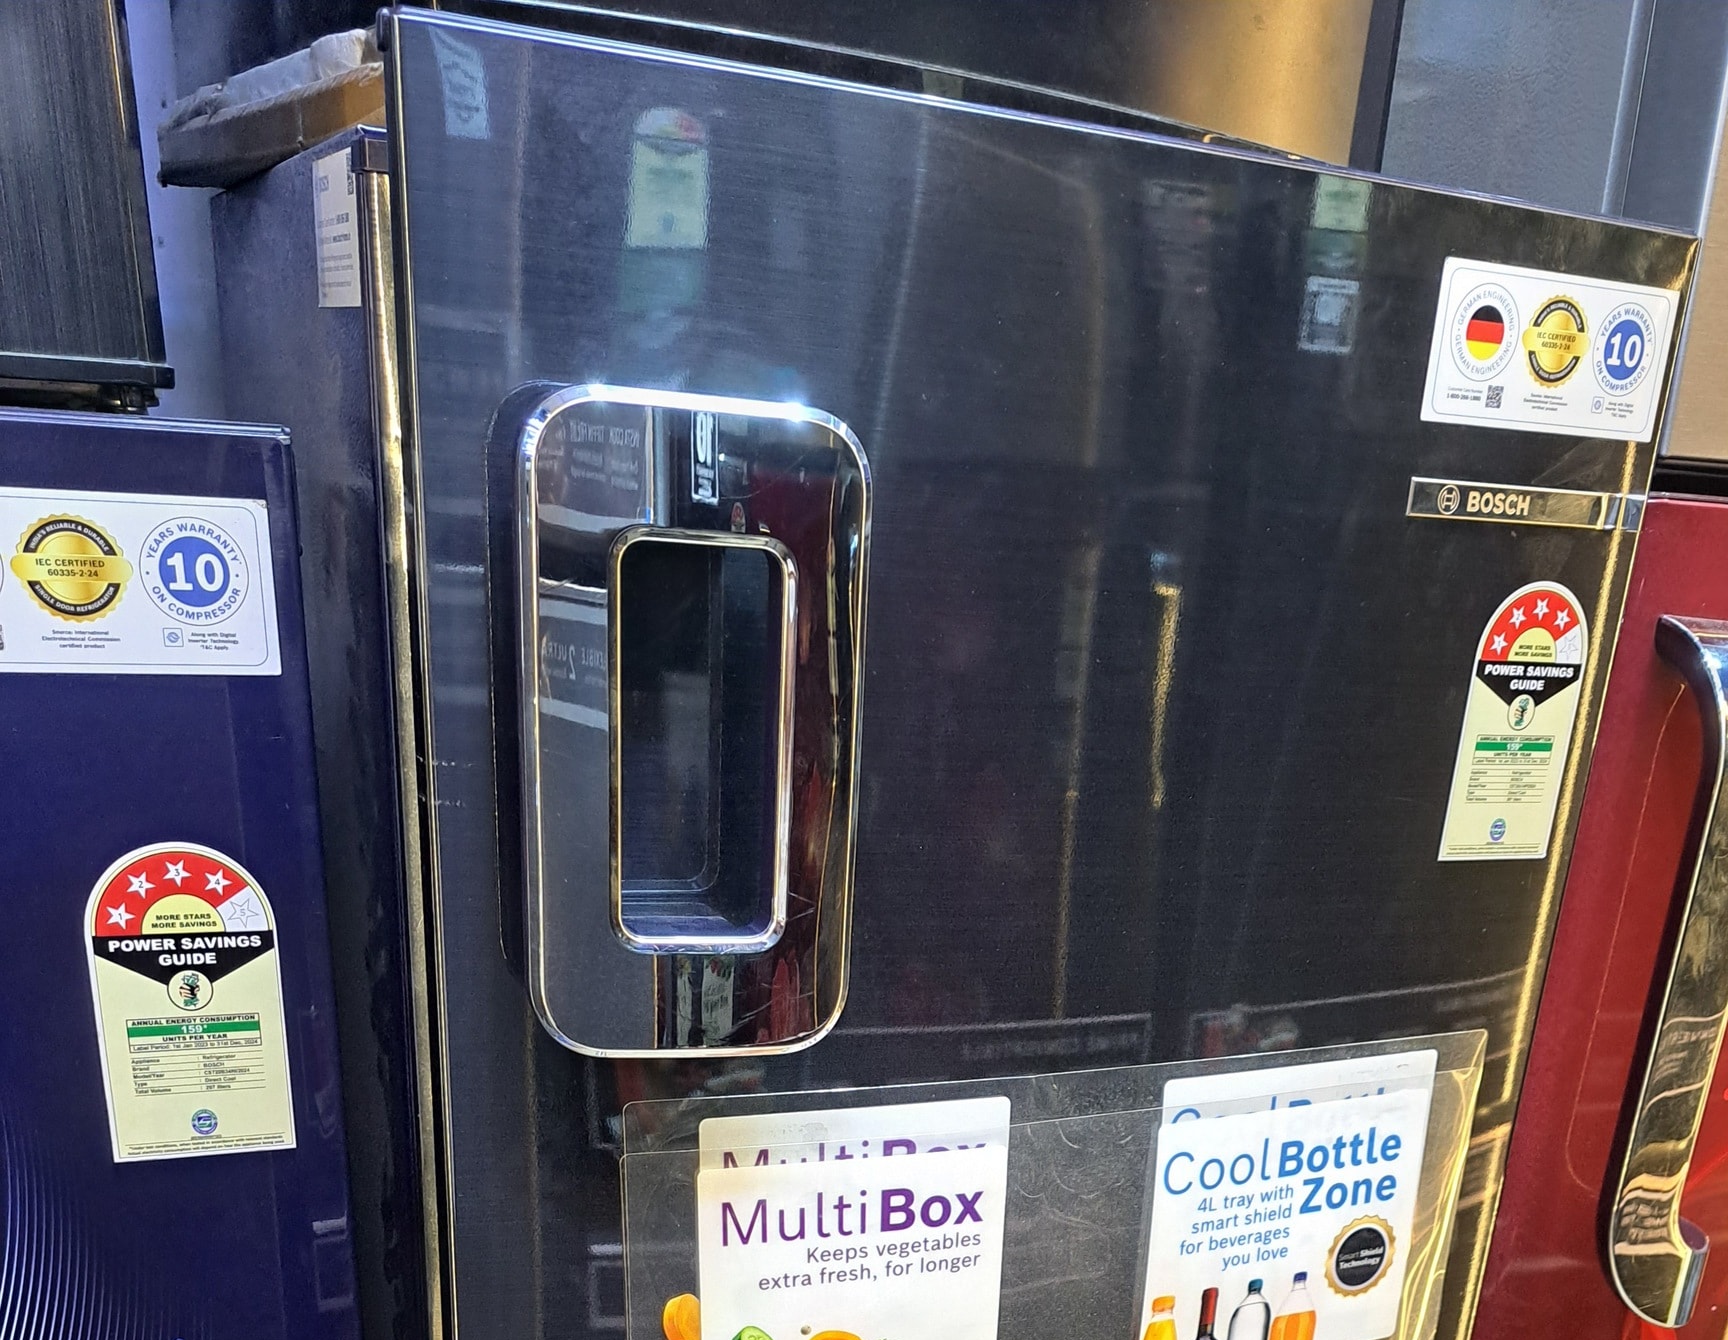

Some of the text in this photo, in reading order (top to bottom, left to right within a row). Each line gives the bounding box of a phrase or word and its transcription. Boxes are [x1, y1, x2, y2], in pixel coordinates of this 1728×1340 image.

[1458, 292, 1482, 325] GERMAN
[1483, 289, 1515, 331] ENGINEERING
[1600, 311, 1622, 337] YEARS
[1455, 334, 1471, 370] GERMAN
[1470, 341, 1513, 375] ENGINEERING
[1606, 332, 1644, 369] 10
[1595, 360, 1606, 382] ON
[1602, 366, 1646, 391] COMPRESSOR
[1466, 490, 1531, 516] BOSCH
[83, 527, 110, 552] DURABLE
[146, 527, 174, 560] YEARS
[35, 558, 105, 568] IEC CERTIFIED
[47, 568, 99, 578] 60335-2-24
[166, 552, 224, 593] 10
[34, 583, 55, 605] SINGLE
[56, 601, 75, 612] DOOR
[152, 585, 241, 621] ON COMPRESSOR
[1484, 664, 1574, 679] POWER SAVINGS
[1509, 679, 1545, 691] GUIDE
[138, 880, 144, 889] 2
[174, 868, 180, 877] 3
[214, 878, 221, 886] 4
[151, 920, 218, 929] MORE SAVINGS
[108, 935, 262, 953] POWER SAVINGS
[158, 952, 217, 967] GUIDE
[131, 1014, 256, 1027] ANNUAL ENERGY CONSUMPTION
[162, 1035, 187, 1043] UNITS
[206, 1033, 228, 1041] YEAR
[1197, 1184, 1294, 1213] 4L tray with
[1298, 1174, 1398, 1215] Zone
[1191, 1203, 1293, 1235] smart shield
[806, 1231, 982, 1266] Keeps vegetables
[1180, 1226, 1290, 1256] for beverages
[1339, 1246, 1384, 1261] Smart Shield
[758, 1252, 981, 1291] extra fresh, for longer
[1221, 1245, 1289, 1272] you love
[1339, 1256, 1381, 1270] Technology
